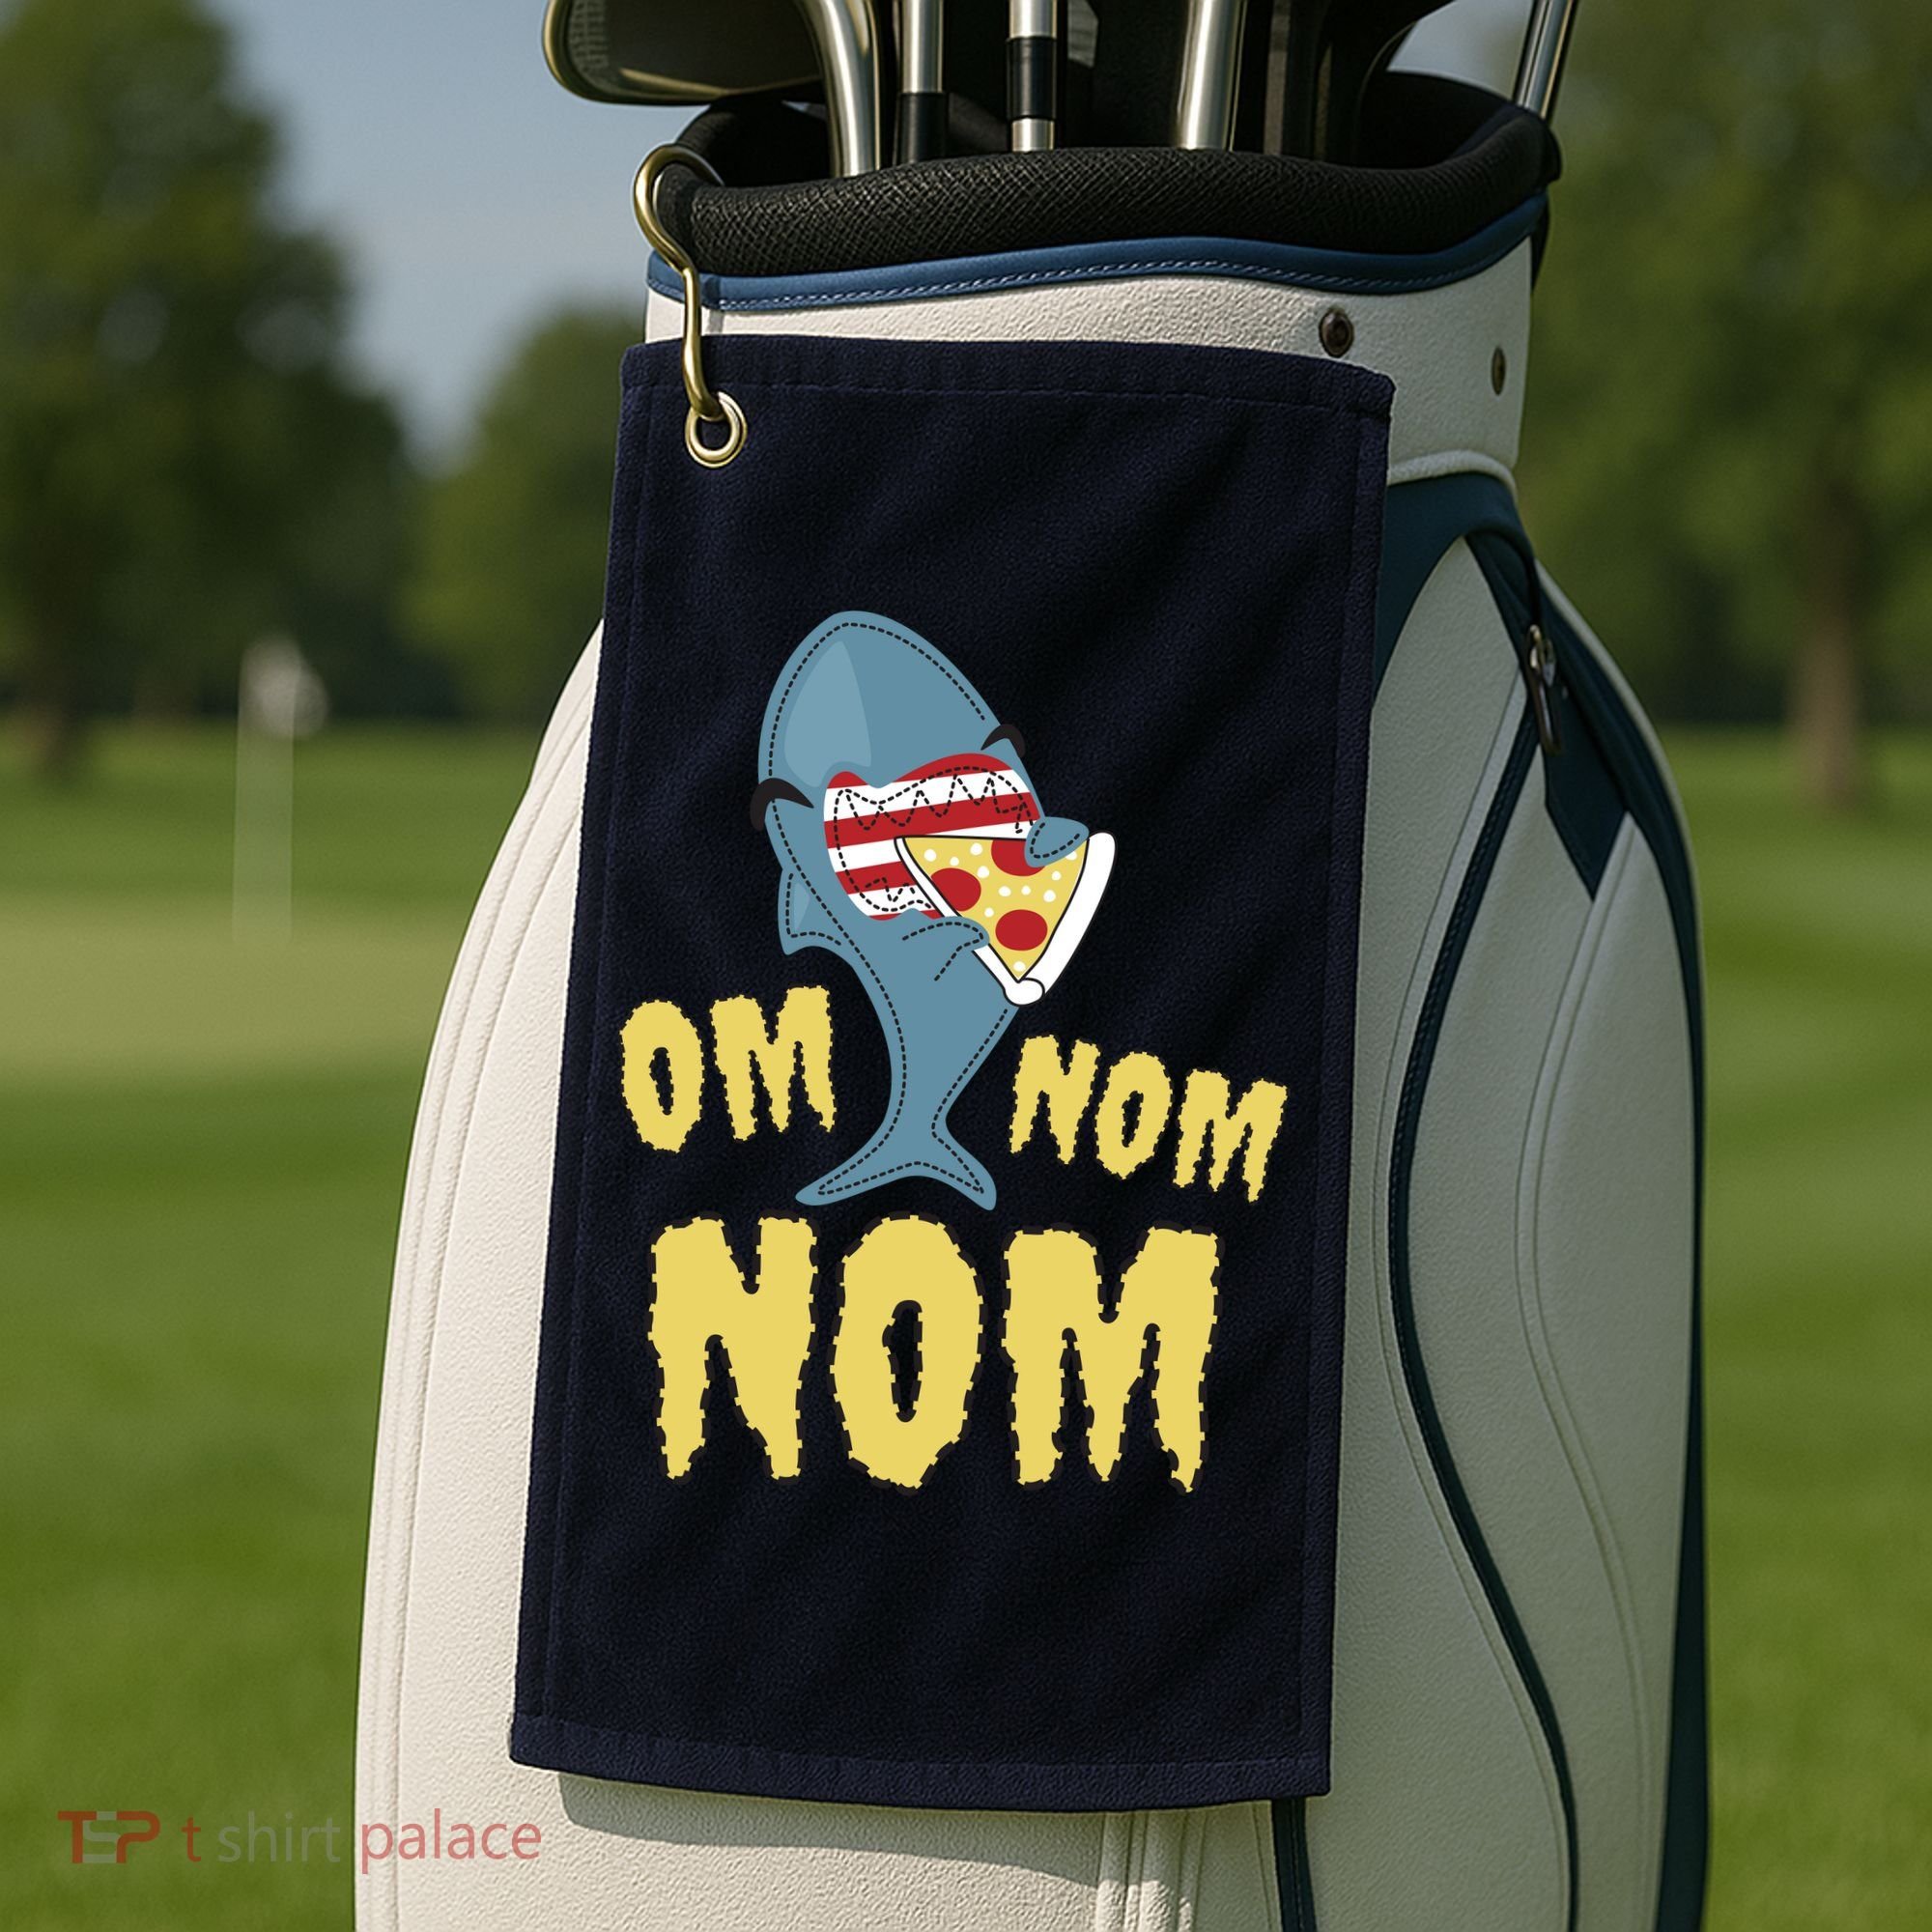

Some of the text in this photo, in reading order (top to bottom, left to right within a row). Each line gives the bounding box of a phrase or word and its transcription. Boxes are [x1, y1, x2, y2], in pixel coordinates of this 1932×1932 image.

[619, 985, 1289, 1204] OM NOM
[647, 1214, 1222, 1493] NOM
